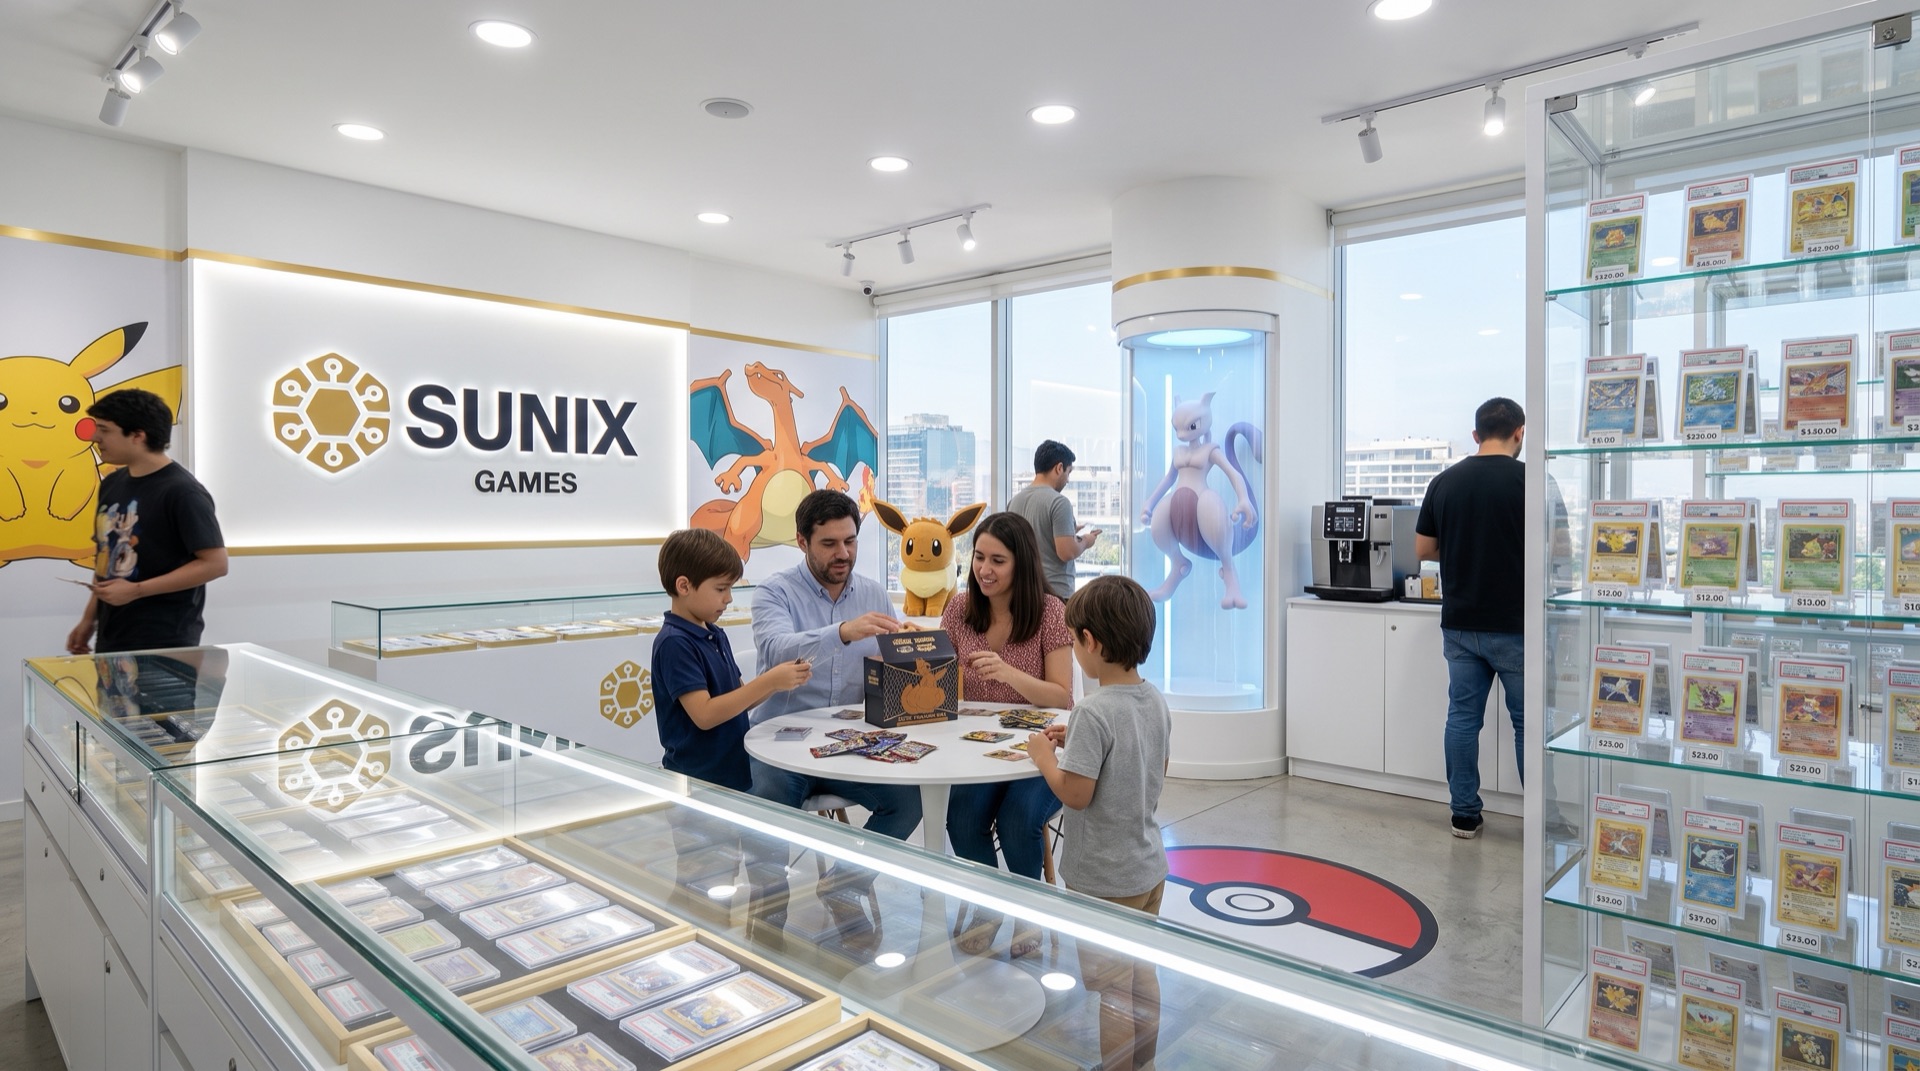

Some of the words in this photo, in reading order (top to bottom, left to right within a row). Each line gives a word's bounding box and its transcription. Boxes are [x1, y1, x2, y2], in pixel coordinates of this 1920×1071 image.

[406, 384, 638, 456] SUNIX
[475, 470, 578, 493] GAMES
[1696, 594, 1724, 602] $12.00
[1790, 764, 1821, 775] $29.00
[1688, 913, 1717, 925] $37.00
